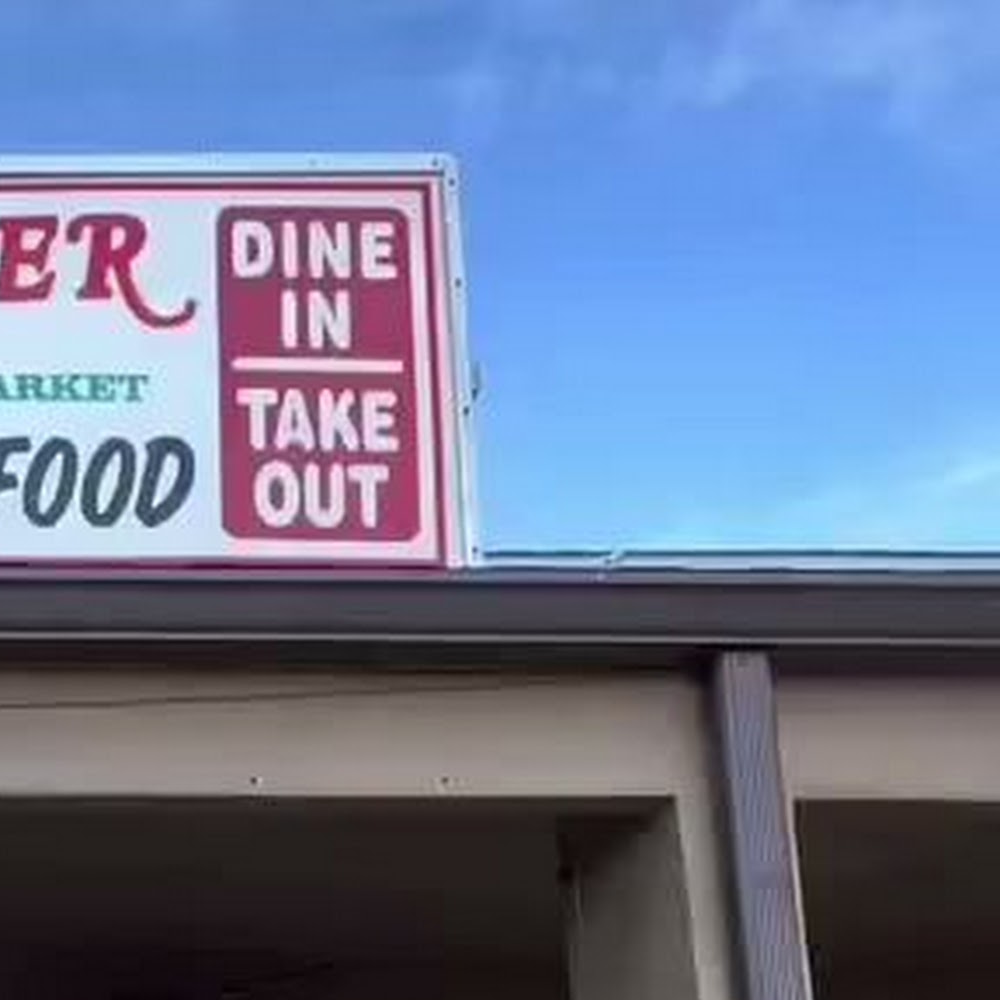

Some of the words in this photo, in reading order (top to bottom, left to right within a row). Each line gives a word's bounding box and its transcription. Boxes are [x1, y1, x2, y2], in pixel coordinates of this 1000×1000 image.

[231, 220, 397, 280] DINE
[281, 291, 351, 350] IN
[236, 388, 399, 454] TAKE
[253, 463, 389, 529] OUT
